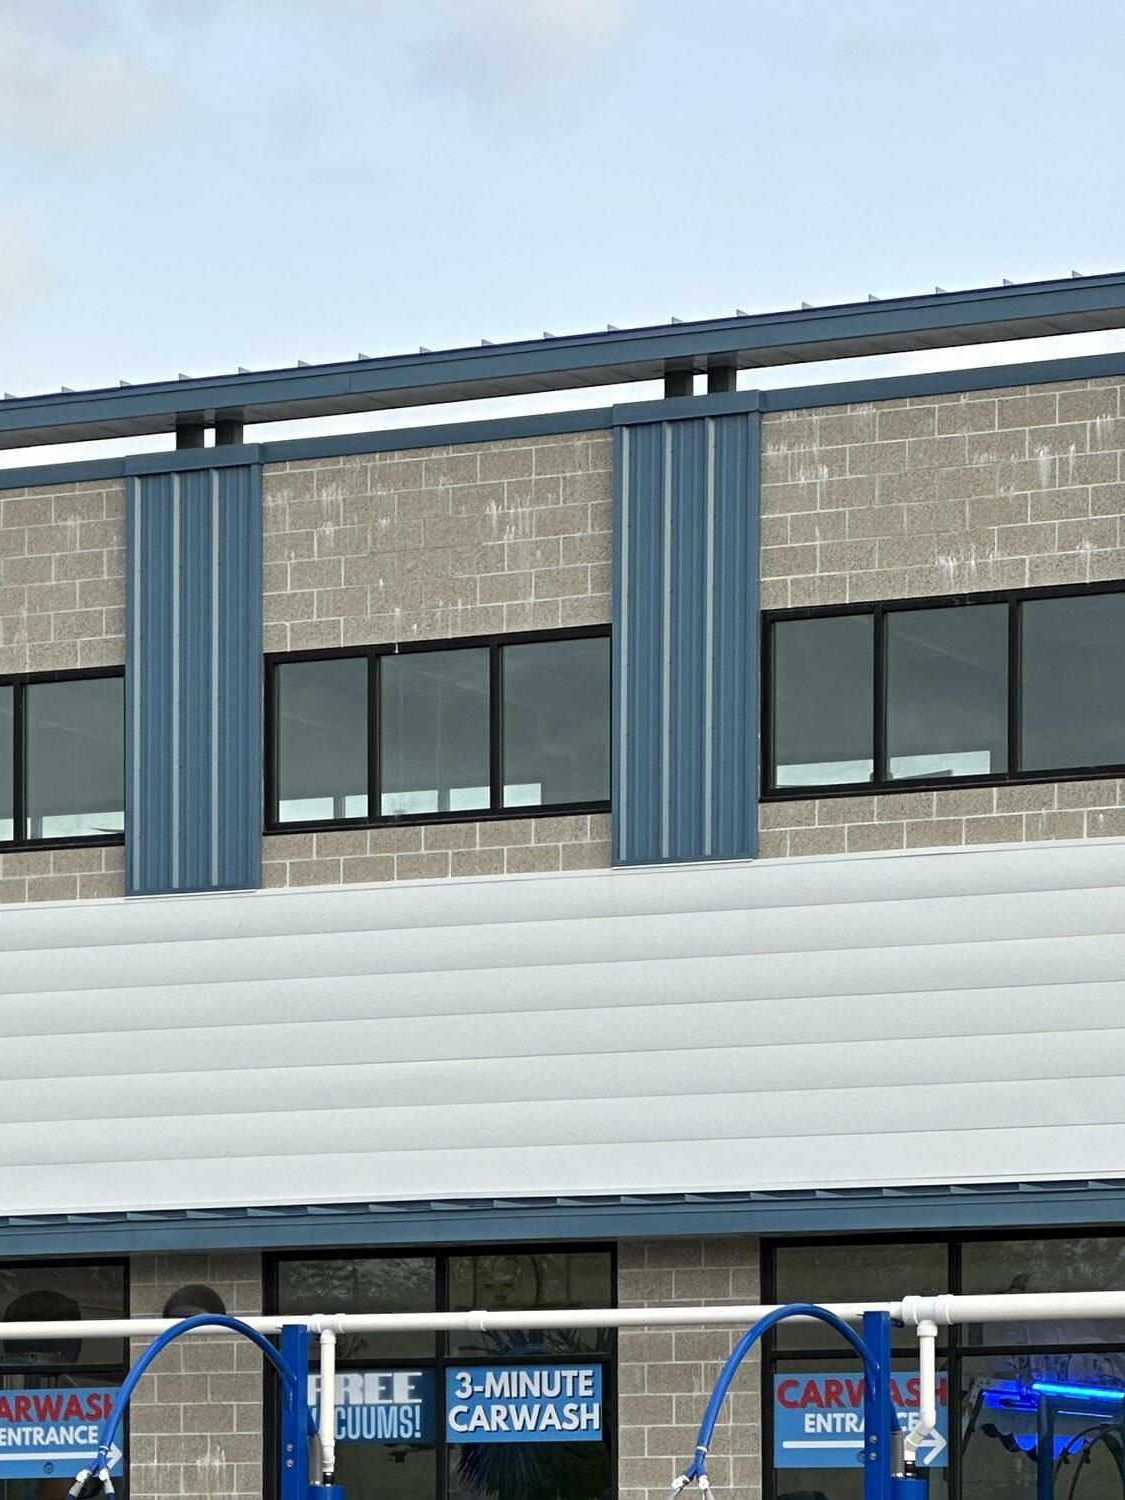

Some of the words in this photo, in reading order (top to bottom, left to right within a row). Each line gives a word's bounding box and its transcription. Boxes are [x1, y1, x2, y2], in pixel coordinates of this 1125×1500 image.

[455, 1370, 593, 1399] 3-MINUTE
[309, 1405, 421, 1439] CUUMS!
[448, 1403, 600, 1432] CARWASH
[804, 1411, 920, 1433] ENTRCE
